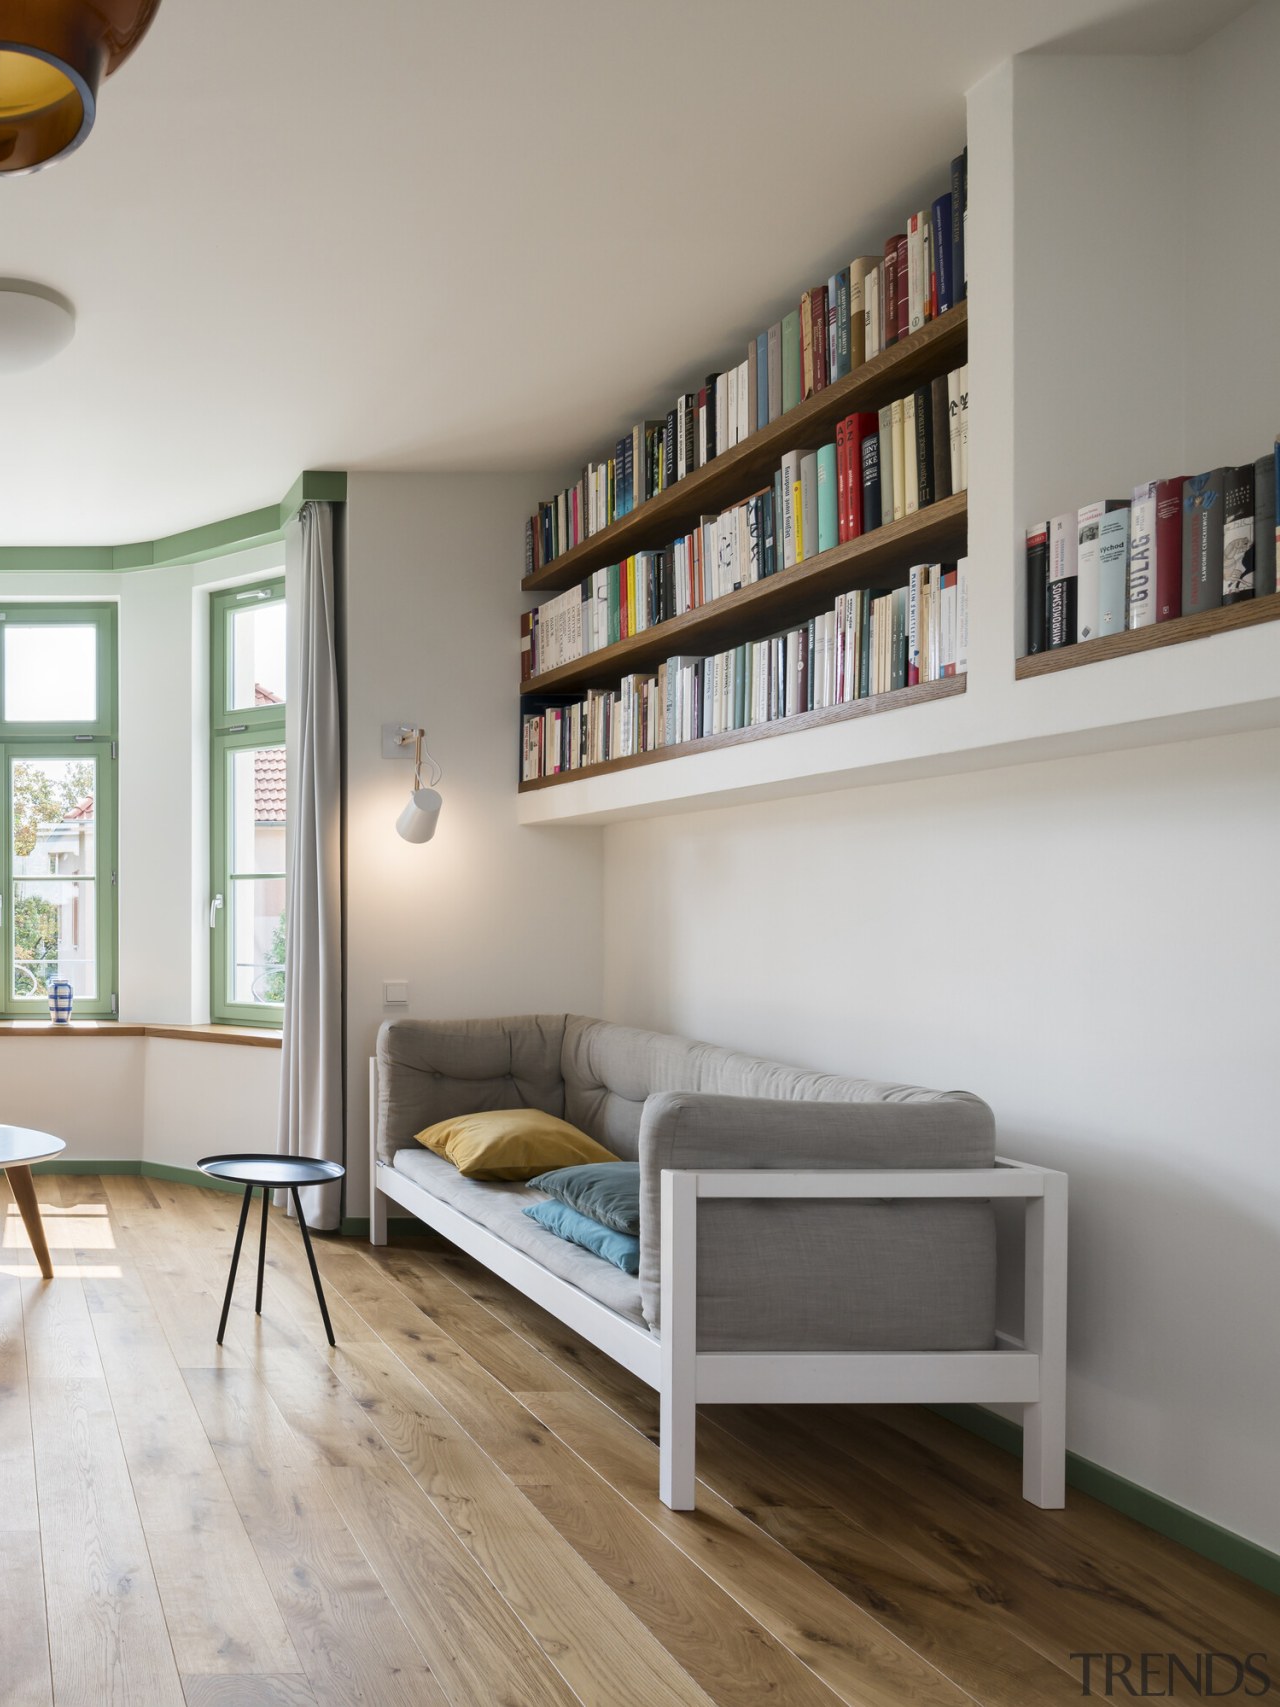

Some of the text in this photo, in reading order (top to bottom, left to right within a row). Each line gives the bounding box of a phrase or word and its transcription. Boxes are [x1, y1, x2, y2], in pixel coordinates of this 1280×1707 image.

[917, 394, 926, 436] LITERATURY
[918, 436, 927, 460] ČESKÉ
[919, 488, 930, 501] III
[1100, 541, 1125, 554] Východ
[1130, 534, 1150, 603] GULAG
[1052, 582, 1062, 645] MIKROKOSMOS
